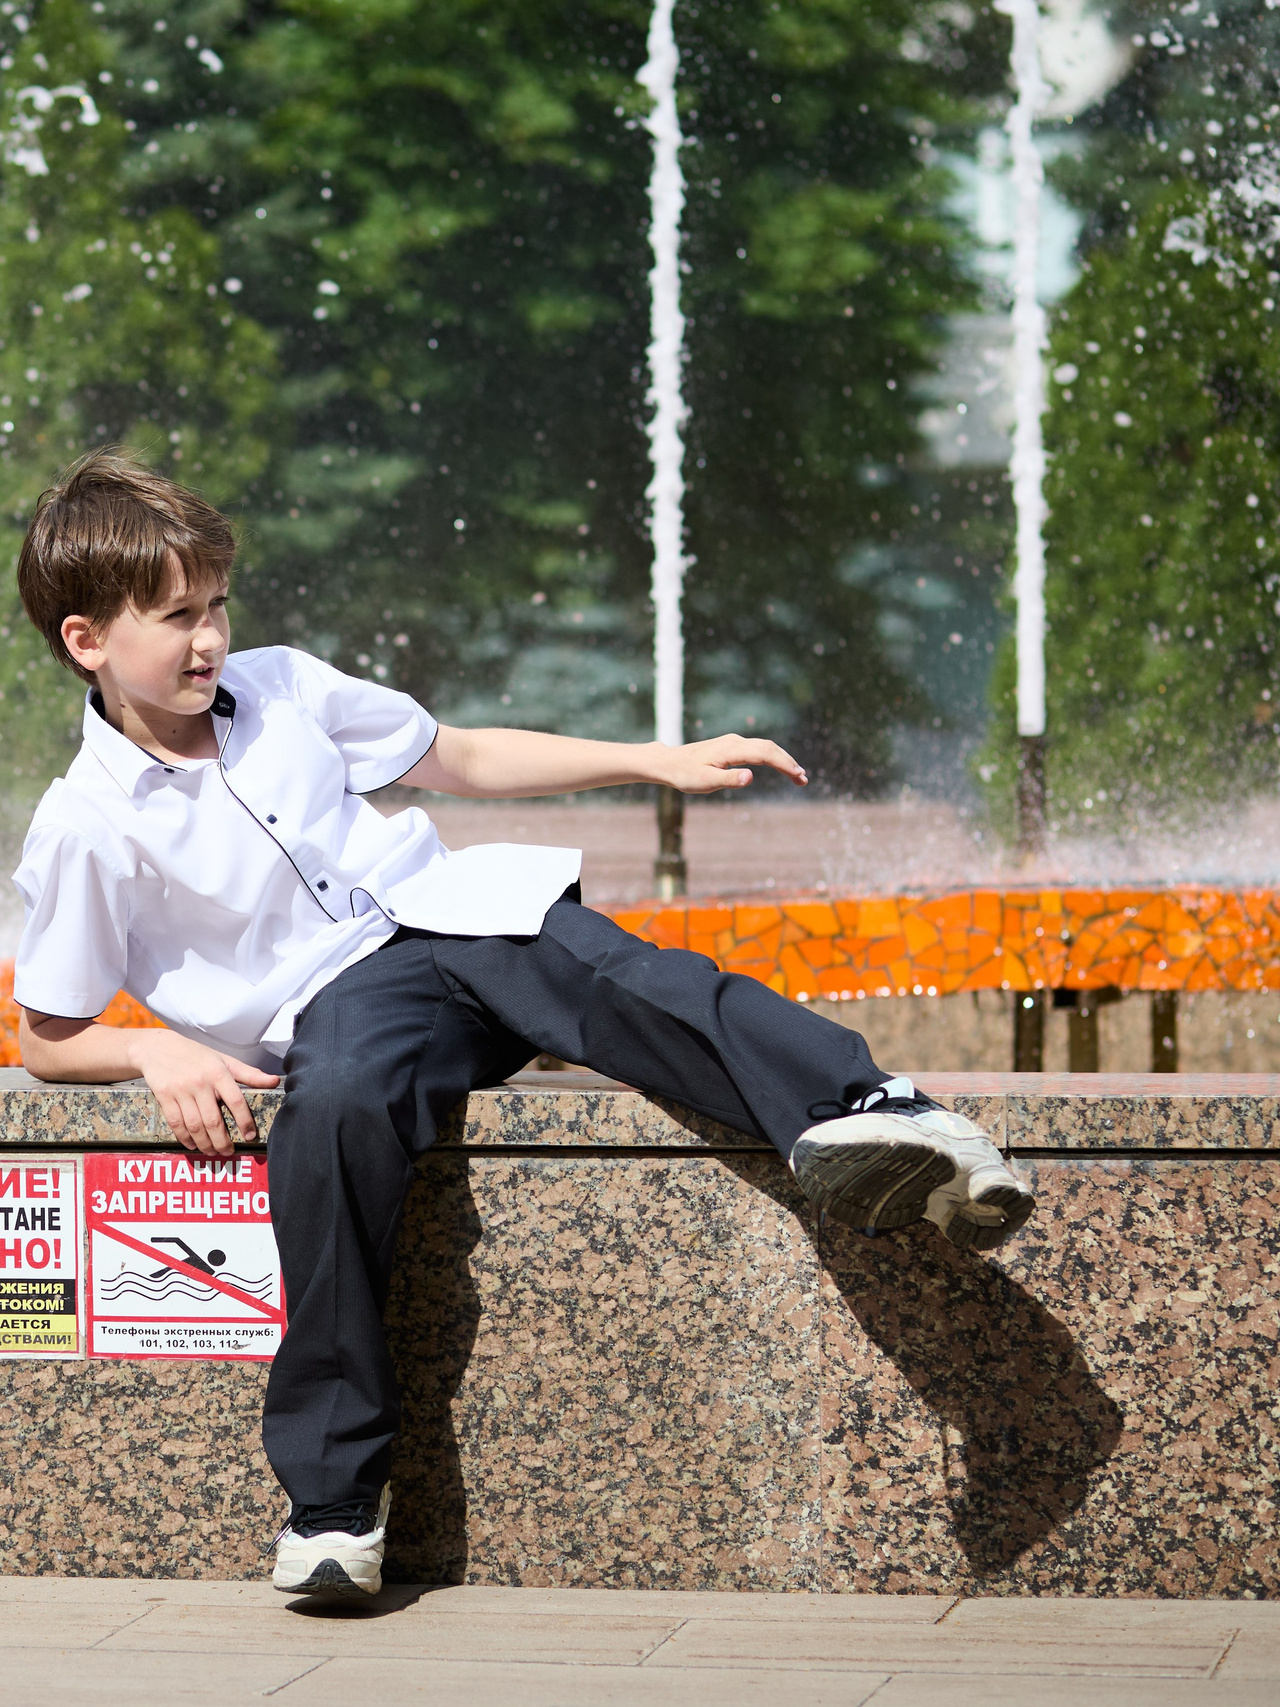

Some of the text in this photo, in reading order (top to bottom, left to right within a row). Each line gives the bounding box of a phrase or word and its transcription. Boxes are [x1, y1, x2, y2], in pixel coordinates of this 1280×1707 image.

[118, 1160, 253, 1183] КУПАНИЕ
[91, 1190, 270, 1219] ЗАПРЕЩЕНО
[101, 1326, 274, 1338] Телефоны экстренных служб:
[140, 1340, 162, 1349] 101,
[165, 1340, 189, 1349] 102,
[192, 1340, 216, 1349] 103,
